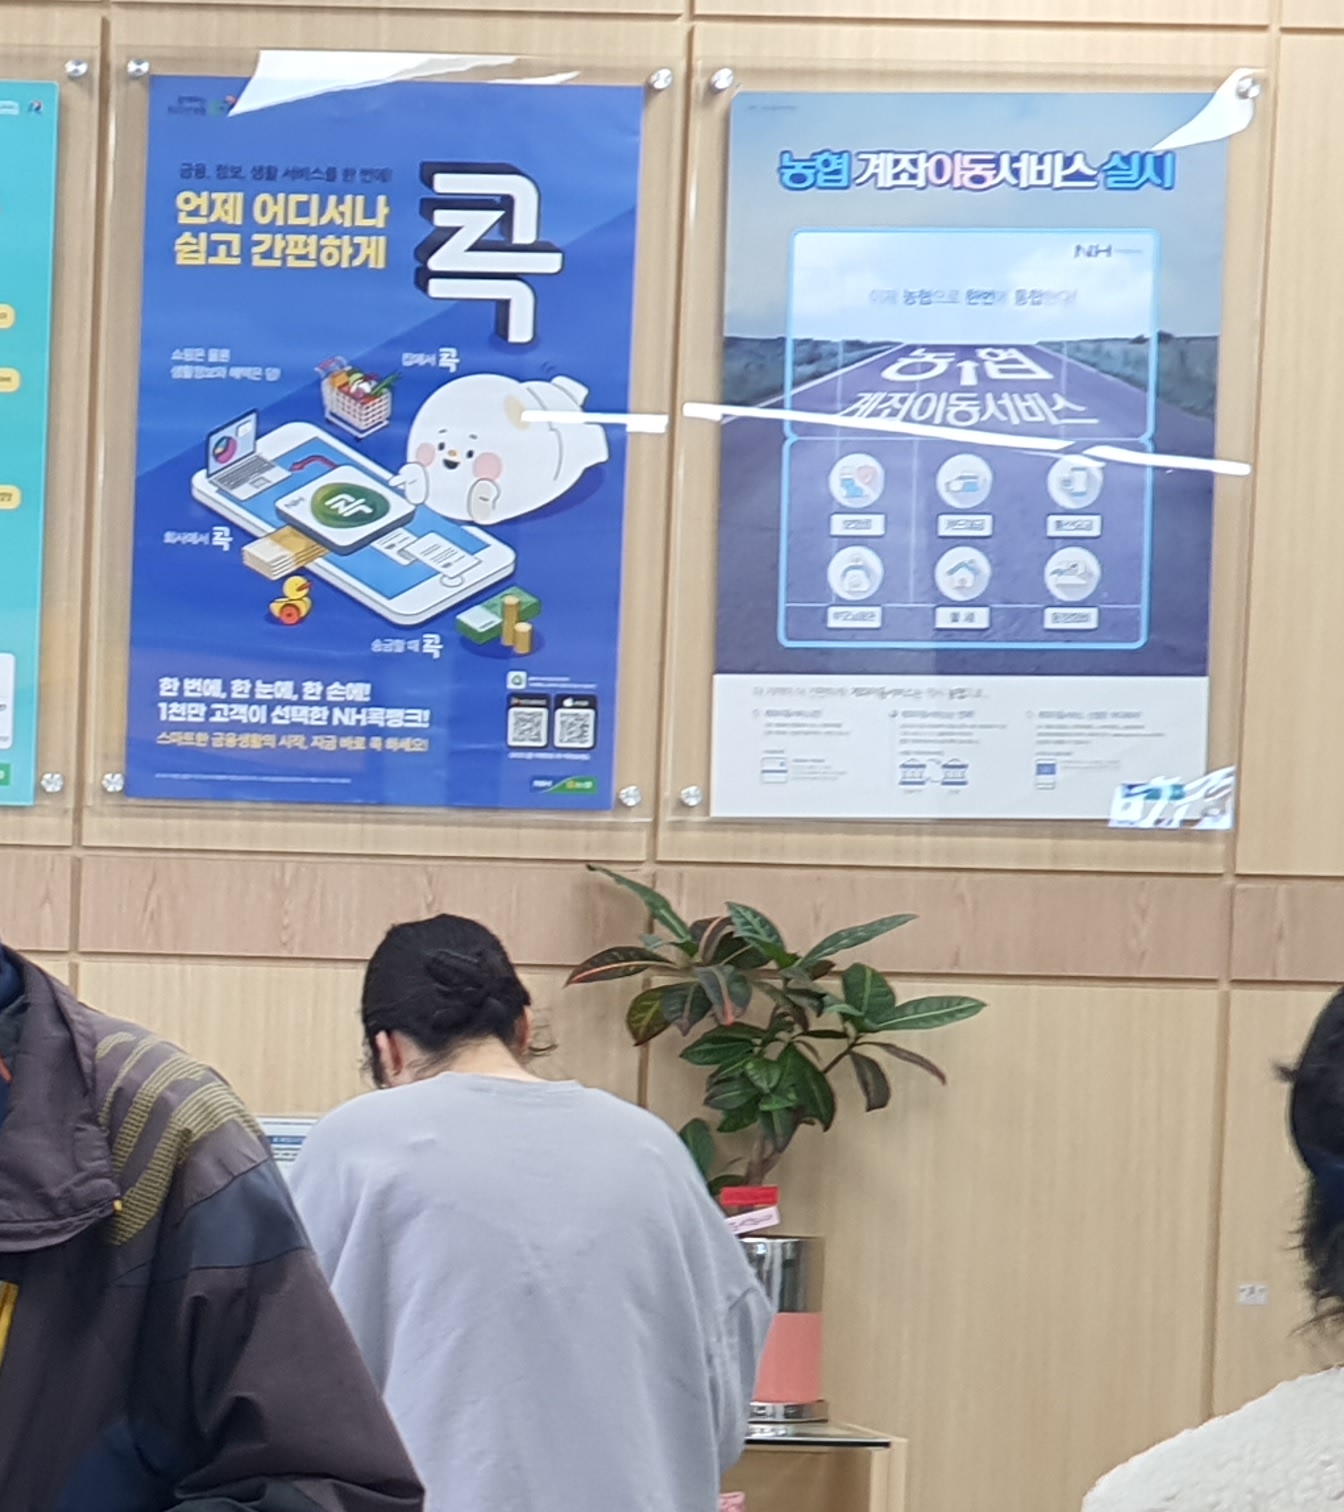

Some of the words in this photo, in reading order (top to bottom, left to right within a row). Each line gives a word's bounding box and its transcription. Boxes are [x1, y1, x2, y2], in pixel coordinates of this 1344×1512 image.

[779, 149, 853, 190] 농협
[854, 150, 1099, 191] 계좌이동서비스
[1102, 150, 1176, 190] 실시
[176, 190, 245, 226] 언제
[253, 192, 390, 228] 어디서나
[175, 231, 242, 266] 쉽고
[251, 233, 387, 269] 간편하게
[416, 161, 564, 344] 콕
[881, 347, 1054, 383] 농협
[837, 391, 1100, 426] 계좌이동서비스
[159, 677, 179, 697] 한
[183, 678, 226, 699] 번에,
[230, 679, 250, 699] 한
[302, 681, 322, 701] 한
[326, 682, 372, 702] 손에!
[158, 701, 206, 722] 1천만
[209, 703, 267, 724] 고객이
[271, 705, 329, 726] 선택한
